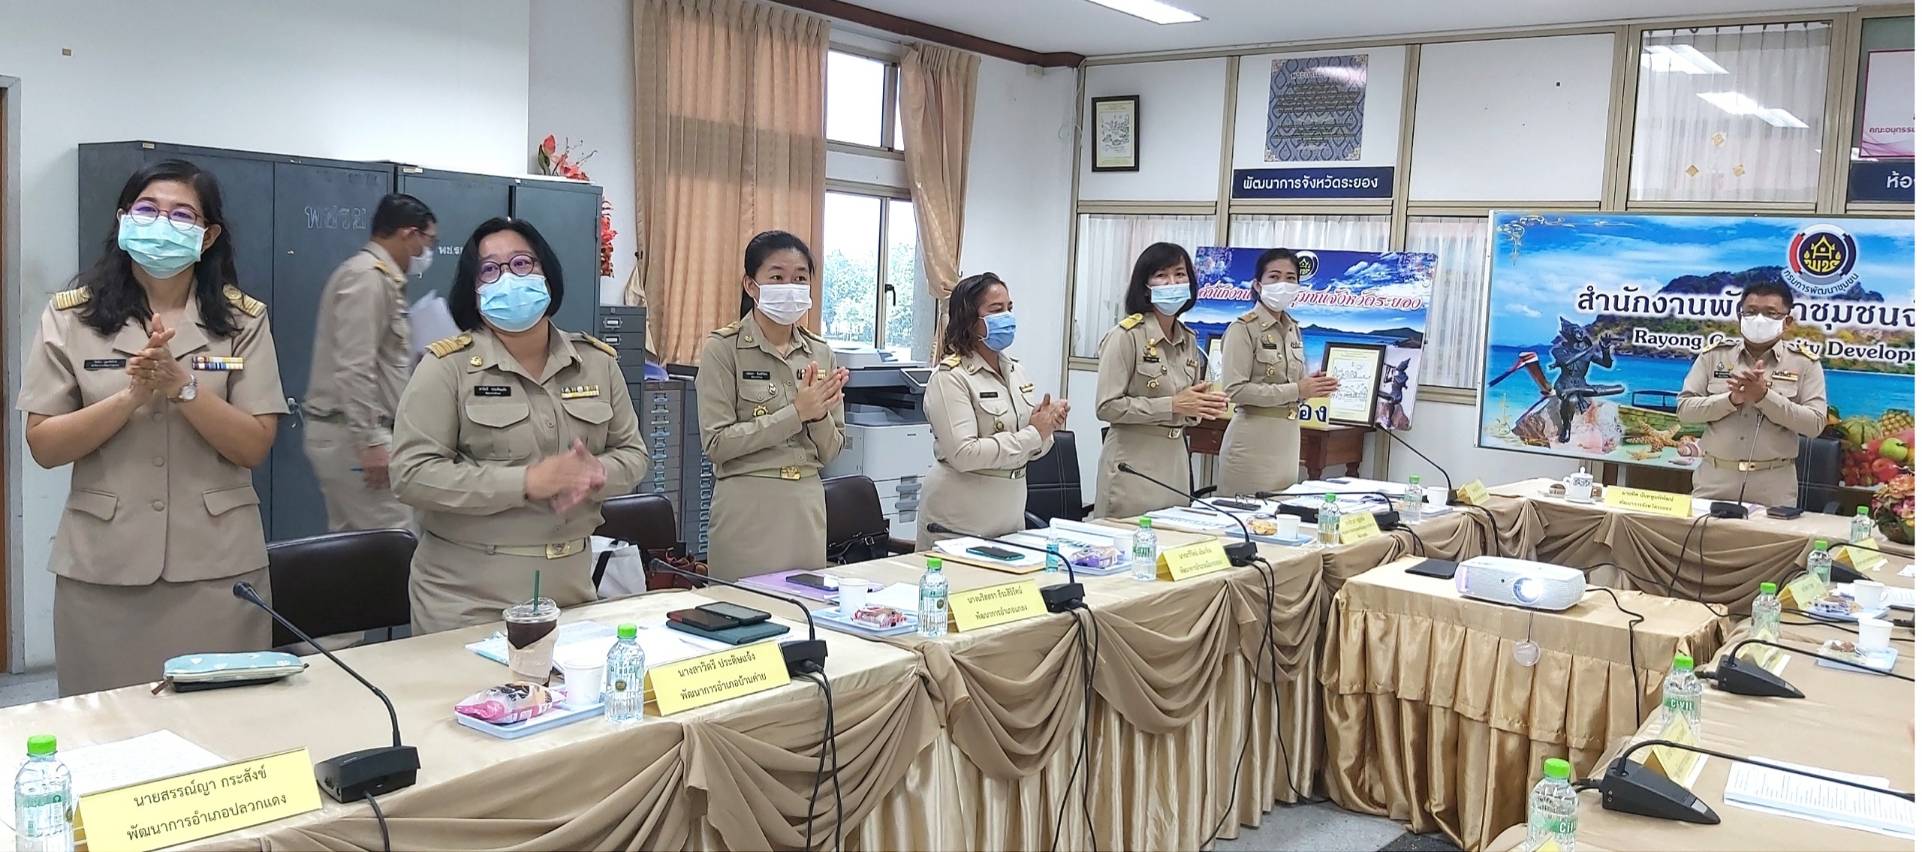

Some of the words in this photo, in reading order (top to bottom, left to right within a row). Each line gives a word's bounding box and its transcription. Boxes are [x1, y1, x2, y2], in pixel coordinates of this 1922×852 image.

[1242, 174, 1379, 191] พัฒนาการจังหวัดระยอง
[1887, 170, 1914, 189] ห้อ
[1783, 270, 1859, 296] กรมการพัฒนาชุมชน
[1634, 329, 1702, 350] Rayong
[1828, 341, 1914, 364] Develop
[679, 672, 768, 701] พัฒนาการอำเภอบ้านค่าย
[133, 780, 217, 807] นายสรรณ์ญา
[220, 764, 268, 788] กระสังข์
[126, 793, 287, 841] พัฒนาการอำเภอปลวกแดง
